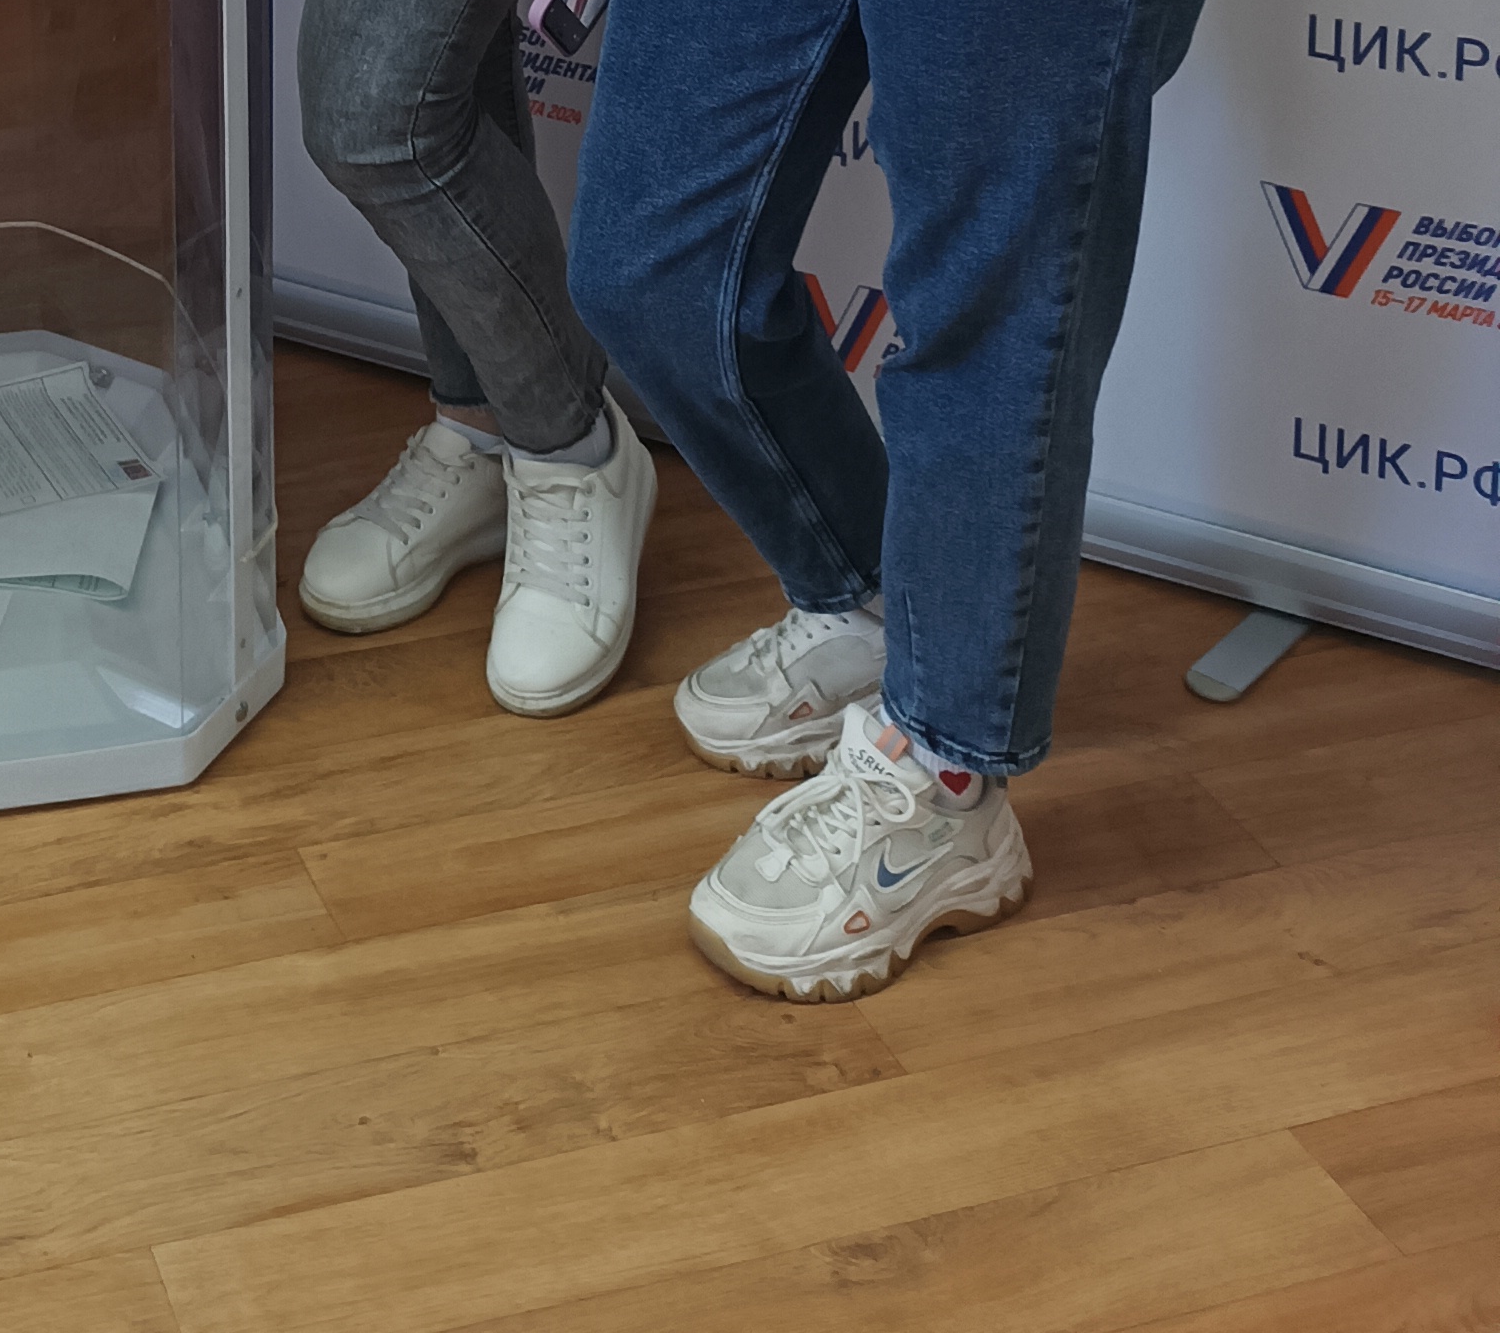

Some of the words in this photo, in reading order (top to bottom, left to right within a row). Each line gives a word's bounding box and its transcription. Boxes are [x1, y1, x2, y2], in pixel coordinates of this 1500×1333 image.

[1308, 14, 1500, 81] ЦИК.Р
[520, 50, 598, 84] ИДЕНТА
[1382, 265, 1498, 302] РОССИИ
[1426, 300, 1496, 327] МАРТА
[1293, 417, 1500, 507] ЦИК.РФ
